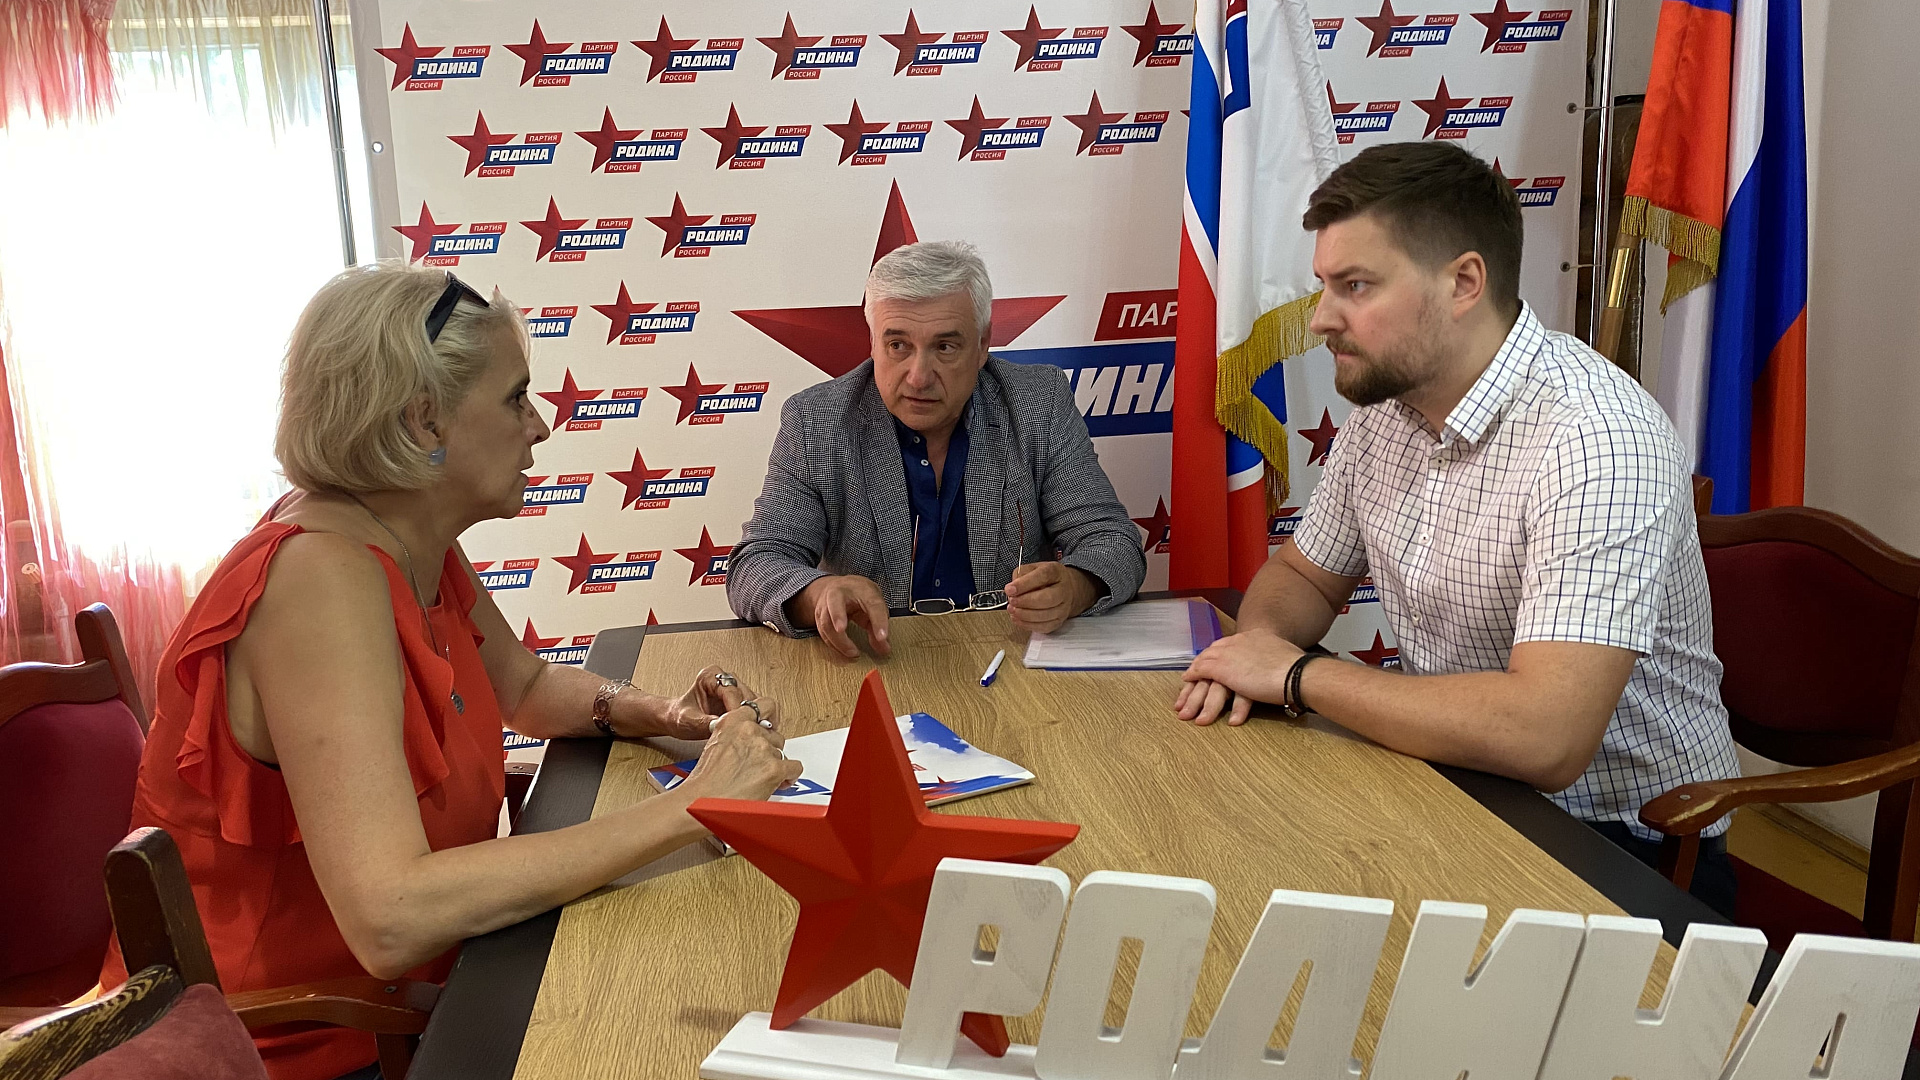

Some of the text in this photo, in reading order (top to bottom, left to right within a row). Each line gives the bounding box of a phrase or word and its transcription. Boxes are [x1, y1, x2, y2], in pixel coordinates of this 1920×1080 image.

[1313, 20, 1340, 28] ПАРТИЯ
[1428, 16, 1455, 24] ПАРТИЯ
[1077, 28, 1105, 37] ПАРТИЯ
[1390, 29, 1446, 43] РОДИНА
[1504, 25, 1559, 39] РОДИНА
[834, 37, 863, 45] ПАРТИЯ
[956, 33, 985, 41] ПАРТИЯ
[710, 40, 740, 48] ПАРТИЯ
[1157, 38, 1194, 52] РОДИ
[1496, 44, 1523, 52] РОССИЯ
[457, 47, 487, 55] ПАРТИЯ
[1038, 42, 1096, 56] РОДИНА
[1382, 48, 1410, 56] РОССИЯ
[796, 51, 854, 64] РОДИНА
[918, 47, 976, 61] РОДИНА
[545, 57, 605, 71] РОДИНА
[671, 54, 731, 68] РОДИНА
[1149, 57, 1177, 65] РОССИЯ
[416, 61, 478, 76] РОДИНА
[1030, 62, 1059, 70] РОССИЯ
[664, 74, 693, 82] РОССИЯ
[788, 70, 817, 78] РОССИЯ
[409, 81, 439, 89] РОССИЯ
[537, 77, 567, 85] РОССИЯ
[1482, 98, 1509, 106] ПАРТИЯ
[1138, 113, 1166, 121] ПАРТИЯ
[1446, 112, 1500, 125] РОДИНА
[1020, 118, 1048, 126] ПАРТИЯ
[1334, 116, 1388, 130] РОДИНА
[900, 123, 929, 131] ПАРТИЯ
[655, 130, 684, 138] ПАРТИЯ
[1100, 126, 1156, 141] РОДИНА
[1438, 130, 1465, 138] РОССИЯ
[528, 134, 558, 142] ПАРТИЯ
[982, 132, 1039, 146] РОДИНА
[1337, 135, 1352, 143] СИЯ
[740, 140, 799, 154] РОДИНА
[862, 136, 920, 150] РОДИНА
[616, 144, 675, 158] РОДИНА
[1092, 146, 1120, 154] РОССИЯ
[489, 148, 550, 162] РОДИНА
[974, 151, 1002, 159] РОССИЯ
[733, 160, 762, 168] РОССИЯ
[855, 156, 883, 164] РОССИЯ
[482, 168, 511, 176] РОССИЯ
[1535, 178, 1562, 186] ПАРТИЯ
[1518, 191, 1553, 203] ДИНА
[473, 224, 503, 232] ПАРТИЯ
[600, 220, 629, 228] ПАРТИЯ
[560, 233, 620, 247] РОДИНА
[685, 229, 744, 243] РОДИНА
[434, 238, 494, 252] РОДИНА
[678, 248, 707, 256] РОССИЯ
[669, 303, 698, 311] ПАРТИЯ
[545, 308, 574, 316] ПАРТИЯ
[1116, 301, 1179, 328] ПАР
[631, 316, 690, 330] РОДИНА
[527, 321, 566, 334] ДИНА
[623, 335, 652, 343] РОССИЯ
[737, 384, 766, 392] ПАРТИЯ
[615, 389, 644, 397] ПАРТИЯ
[700, 397, 757, 411] РОДИНА
[576, 402, 636, 417] РОДИНА
[692, 416, 721, 424] РОССИЯ
[569, 422, 598, 430] РОССИЯ
[683, 468, 712, 476] ПАРТИЯ
[560, 475, 590, 483] ПАРТИЯ
[645, 481, 703, 496] РОДИНА
[522, 488, 581, 503] РОДИНА
[638, 500, 667, 508] РОССИЯ
[519, 508, 544, 516] ОССИЯ
[629, 552, 658, 560] ПАРТИЯ
[506, 560, 535, 569] ПАРТИЯ
[591, 565, 649, 580] РОДИНА
[705, 576, 727, 584] РОССИ
[584, 584, 613, 592] РОССИЯ
[575, 636, 596, 644] ПАРТ
[539, 649, 588, 663] РОДИН
[895, 857, 1920, 1080] РОДИНА
